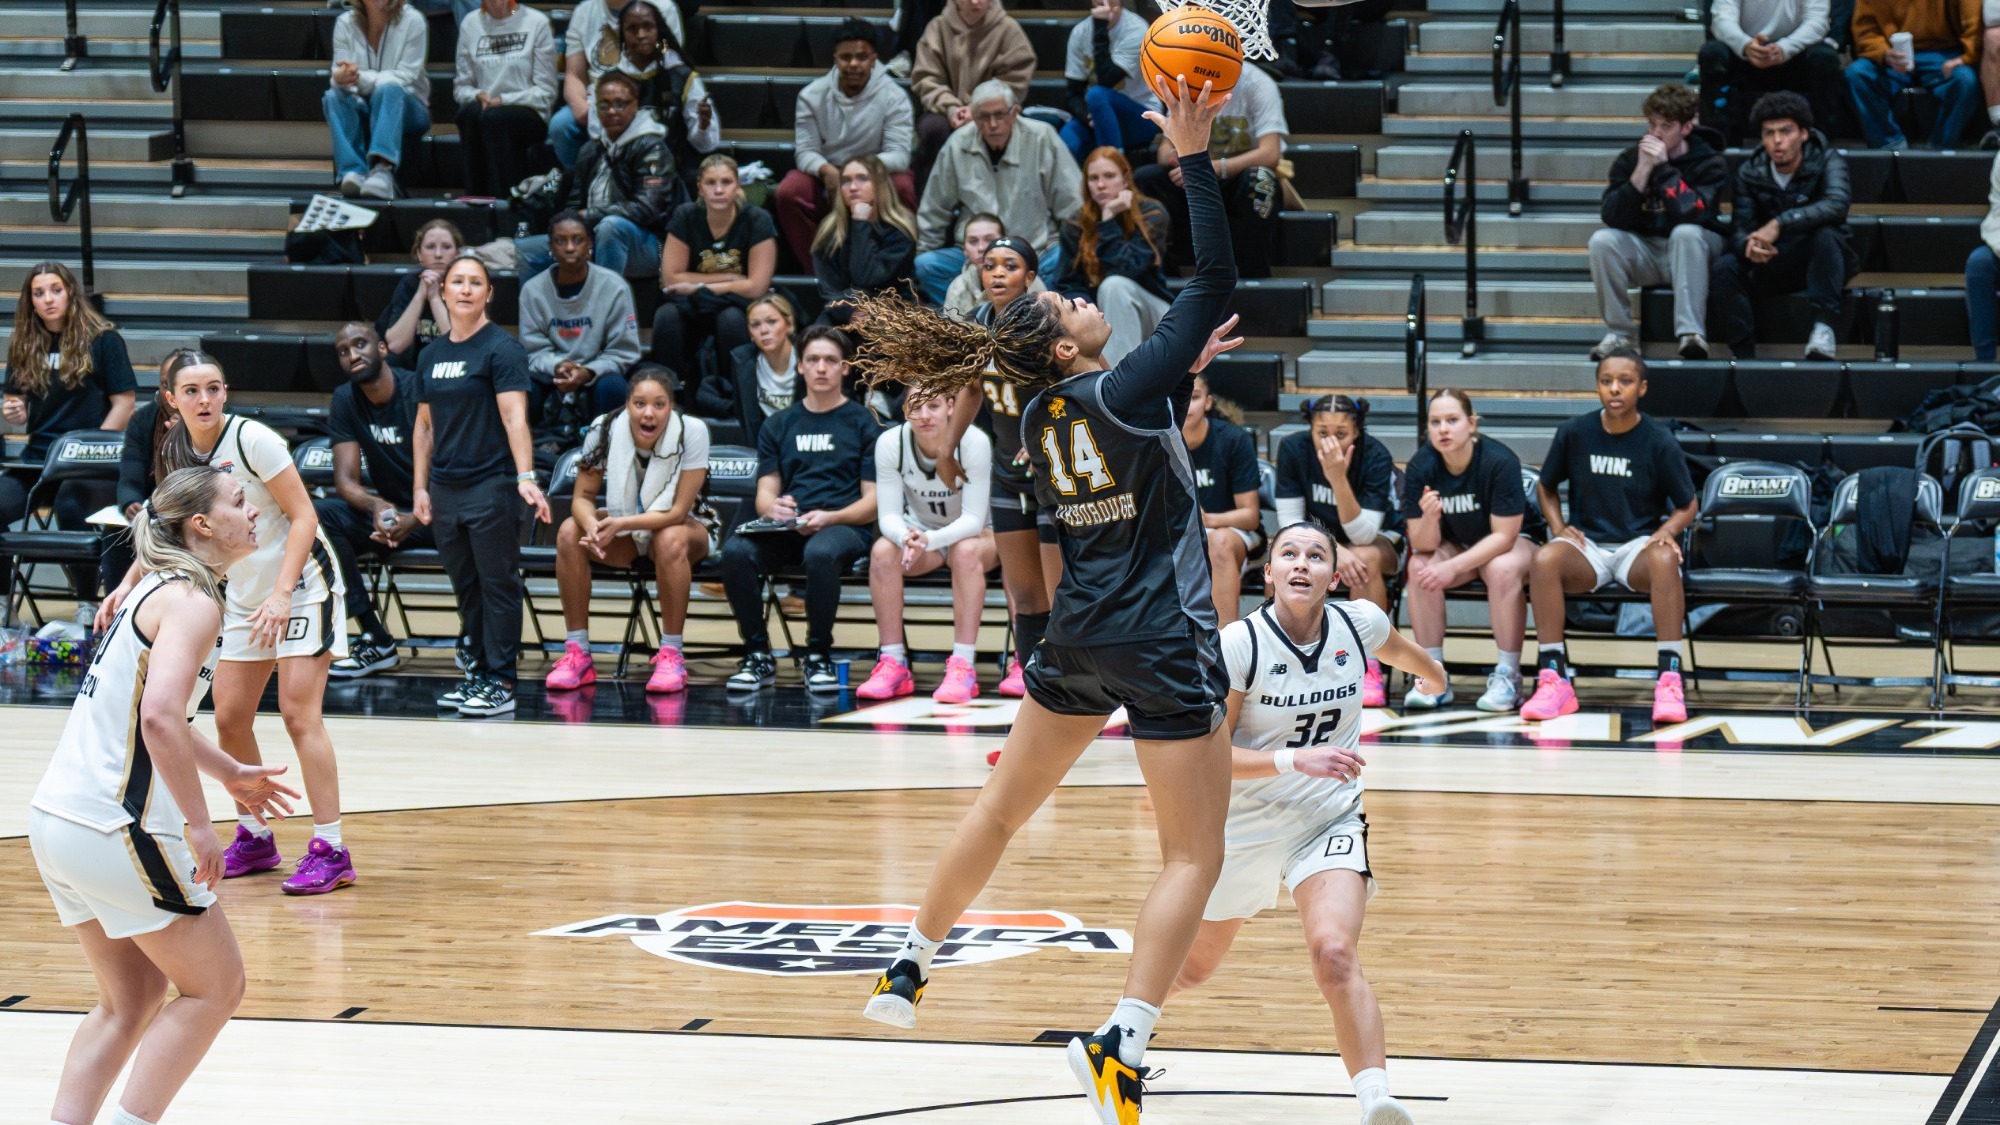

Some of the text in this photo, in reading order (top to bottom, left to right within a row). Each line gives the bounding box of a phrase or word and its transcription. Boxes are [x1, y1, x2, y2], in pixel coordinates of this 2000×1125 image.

[1177, 24, 1239, 53] Wilson
[431, 361, 468, 379] WIN.
[983, 380, 1020, 417] 24
[61, 442, 125, 459] BRYANT
[795, 433, 835, 452] WIN.
[708, 460, 755, 471] RYANT
[1041, 419, 1116, 496] 14
[1589, 454, 1633, 478] WIN.
[1195, 469, 1215, 488] N.
[1722, 477, 1792, 494] BRYANT
[1311, 483, 1338, 506] WI
[1440, 493, 1481, 515] WIN.
[926, 501, 948, 518] 11
[285, 616, 310, 642] B
[1260, 682, 1357, 707] BULLDOGS
[1285, 708, 1341, 748] 32
[1324, 834, 1354, 858] B
